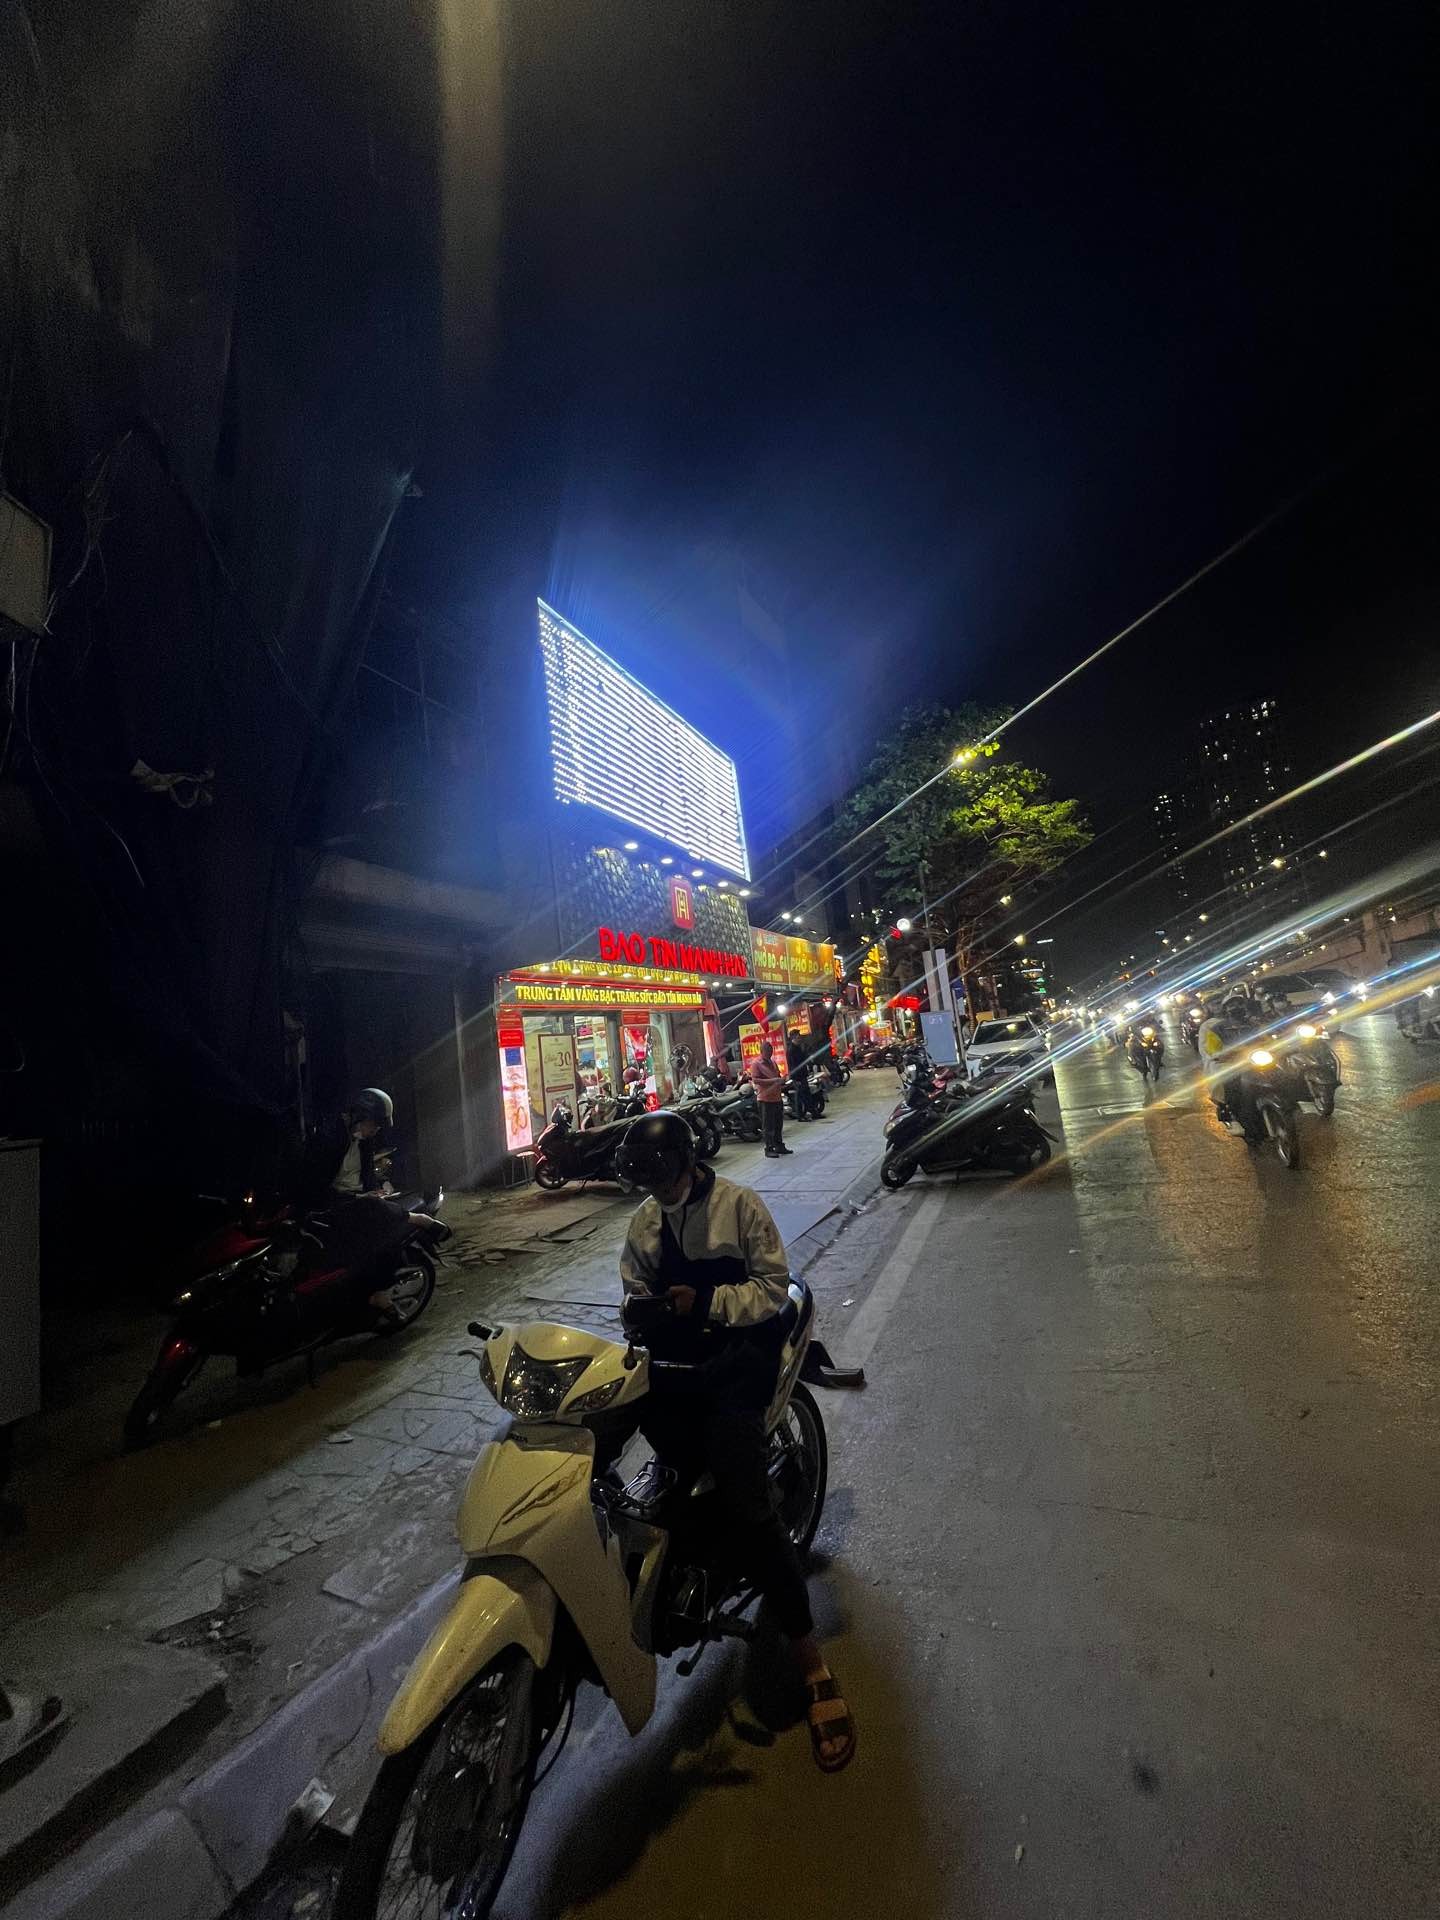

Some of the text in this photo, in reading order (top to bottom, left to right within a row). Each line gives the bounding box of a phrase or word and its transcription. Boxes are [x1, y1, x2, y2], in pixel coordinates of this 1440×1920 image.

[515, 985, 553, 1001] TRUNG
[553, 985, 575, 1001] TÂM
[575, 985, 599, 1002] VÀNG
[599, 990, 615, 1004] BẠC
